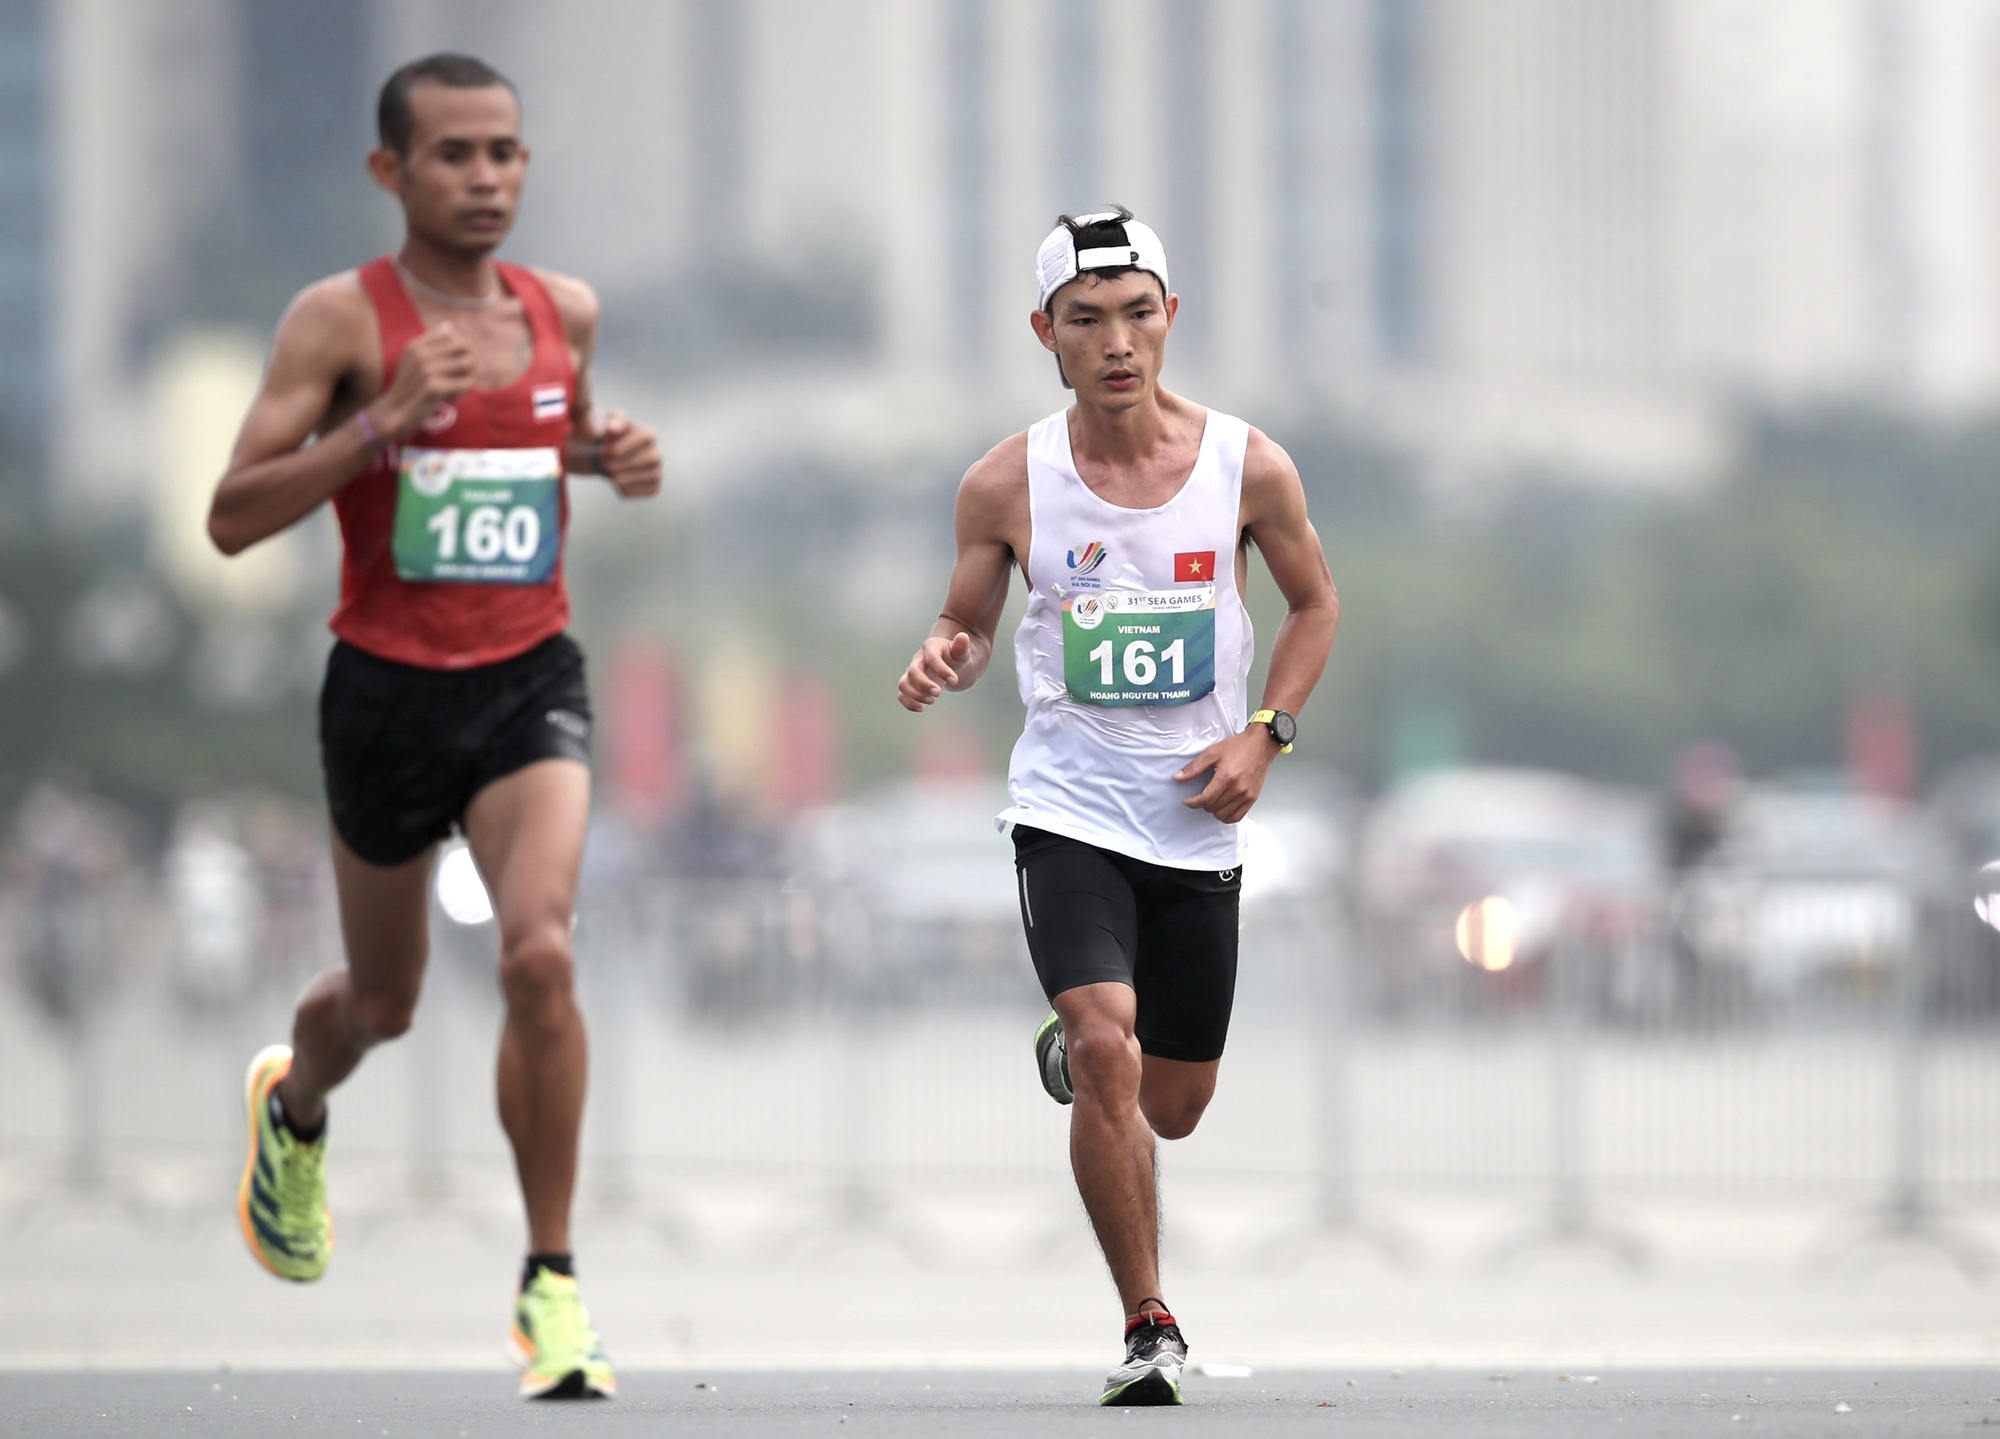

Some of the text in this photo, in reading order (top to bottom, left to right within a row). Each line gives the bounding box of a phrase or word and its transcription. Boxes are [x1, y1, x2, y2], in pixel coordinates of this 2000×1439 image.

[427, 504, 540, 562] 160
[1127, 594, 1203, 606] 31ST SEA GAMES
[1117, 625, 1161, 634] VIETNAM
[1089, 638, 1186, 686] 161
[1090, 689, 1190, 700] HOANG NGUYEN THANH
